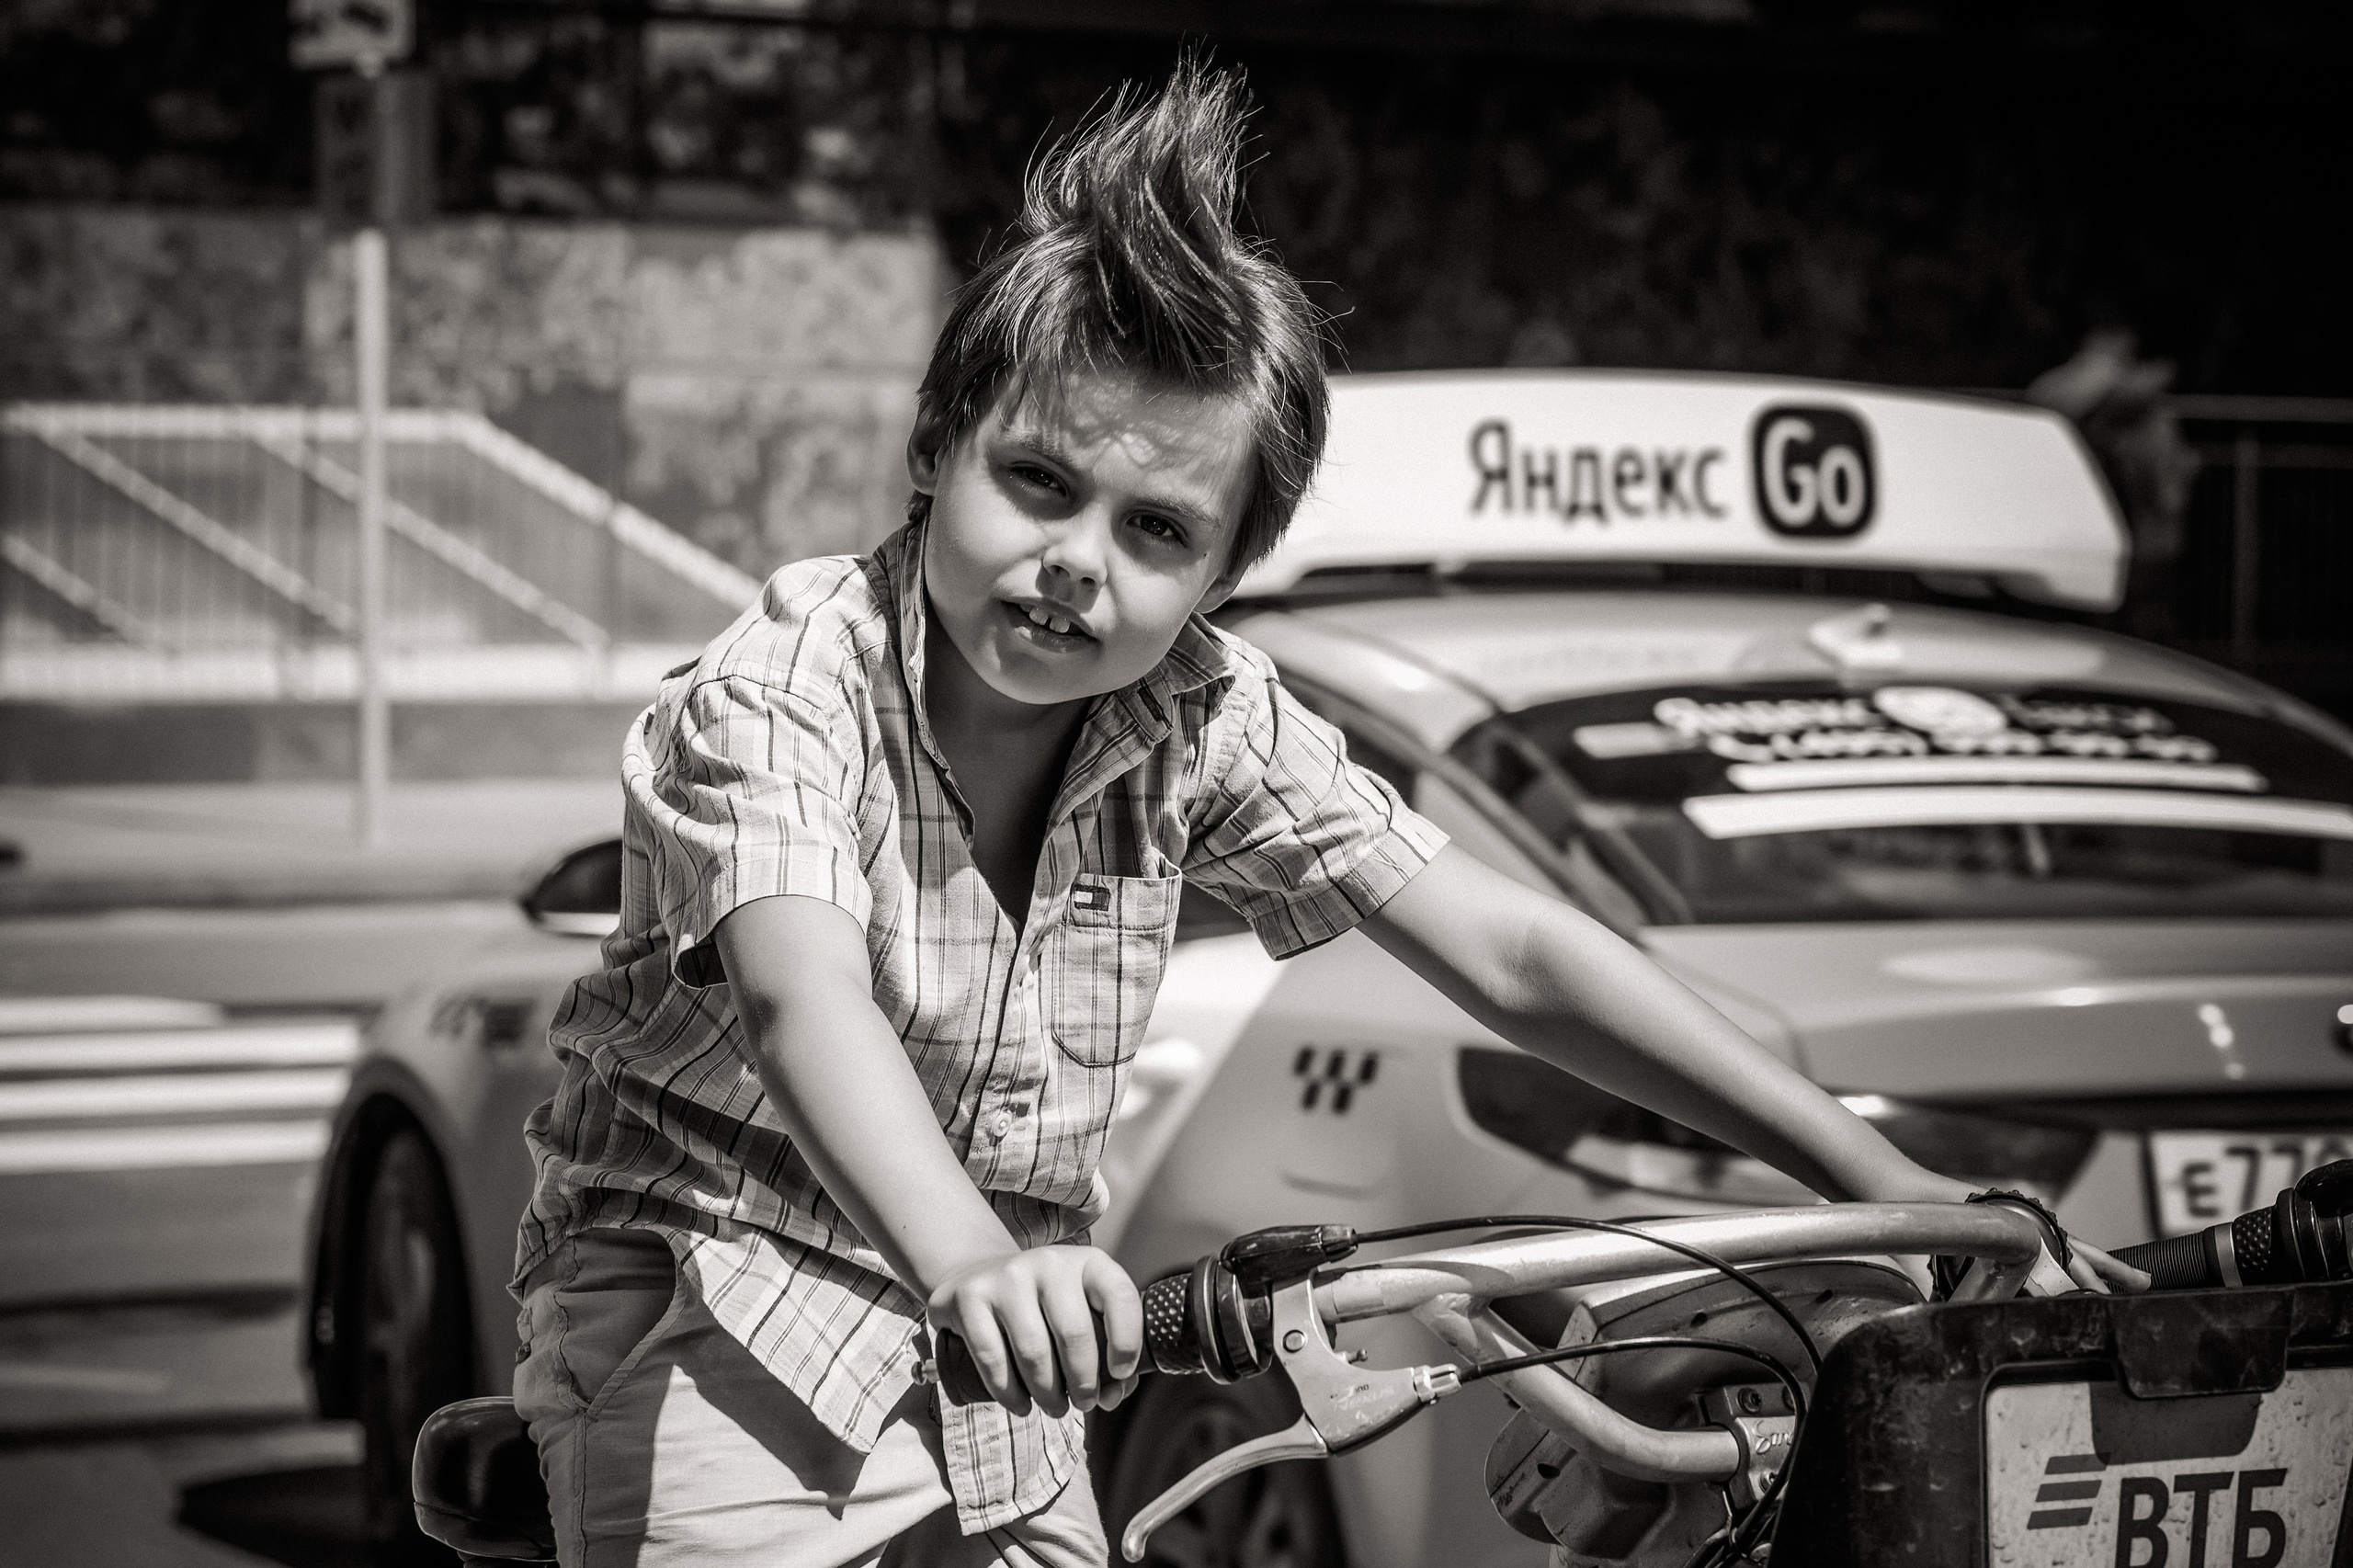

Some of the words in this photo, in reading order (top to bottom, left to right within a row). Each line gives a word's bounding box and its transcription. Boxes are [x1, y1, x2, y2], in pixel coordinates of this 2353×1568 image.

[1468, 416, 1727, 527] Яндекс
[1761, 415, 1867, 528] Go
[2115, 1467, 2288, 1568] ВТБ
